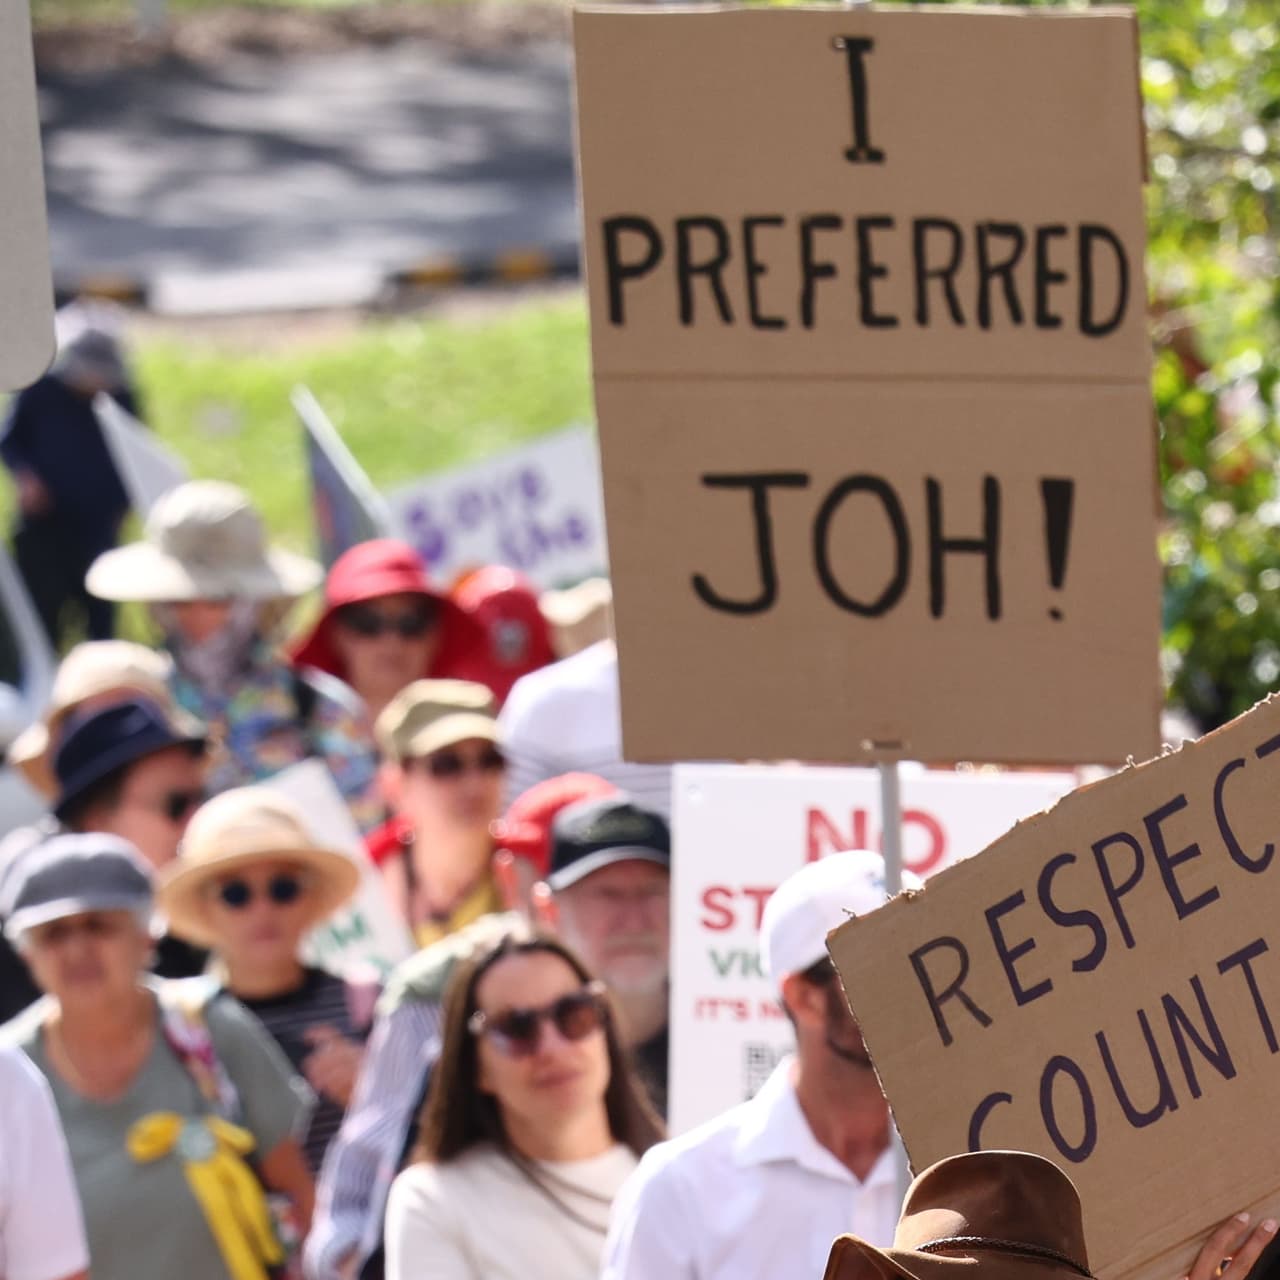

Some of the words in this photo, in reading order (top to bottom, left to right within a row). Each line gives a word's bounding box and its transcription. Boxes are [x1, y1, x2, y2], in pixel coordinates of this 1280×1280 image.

[832, 36, 886, 164] I
[602, 214, 1130, 337] PREFERRED
[692, 471, 1075, 622] JOH!
